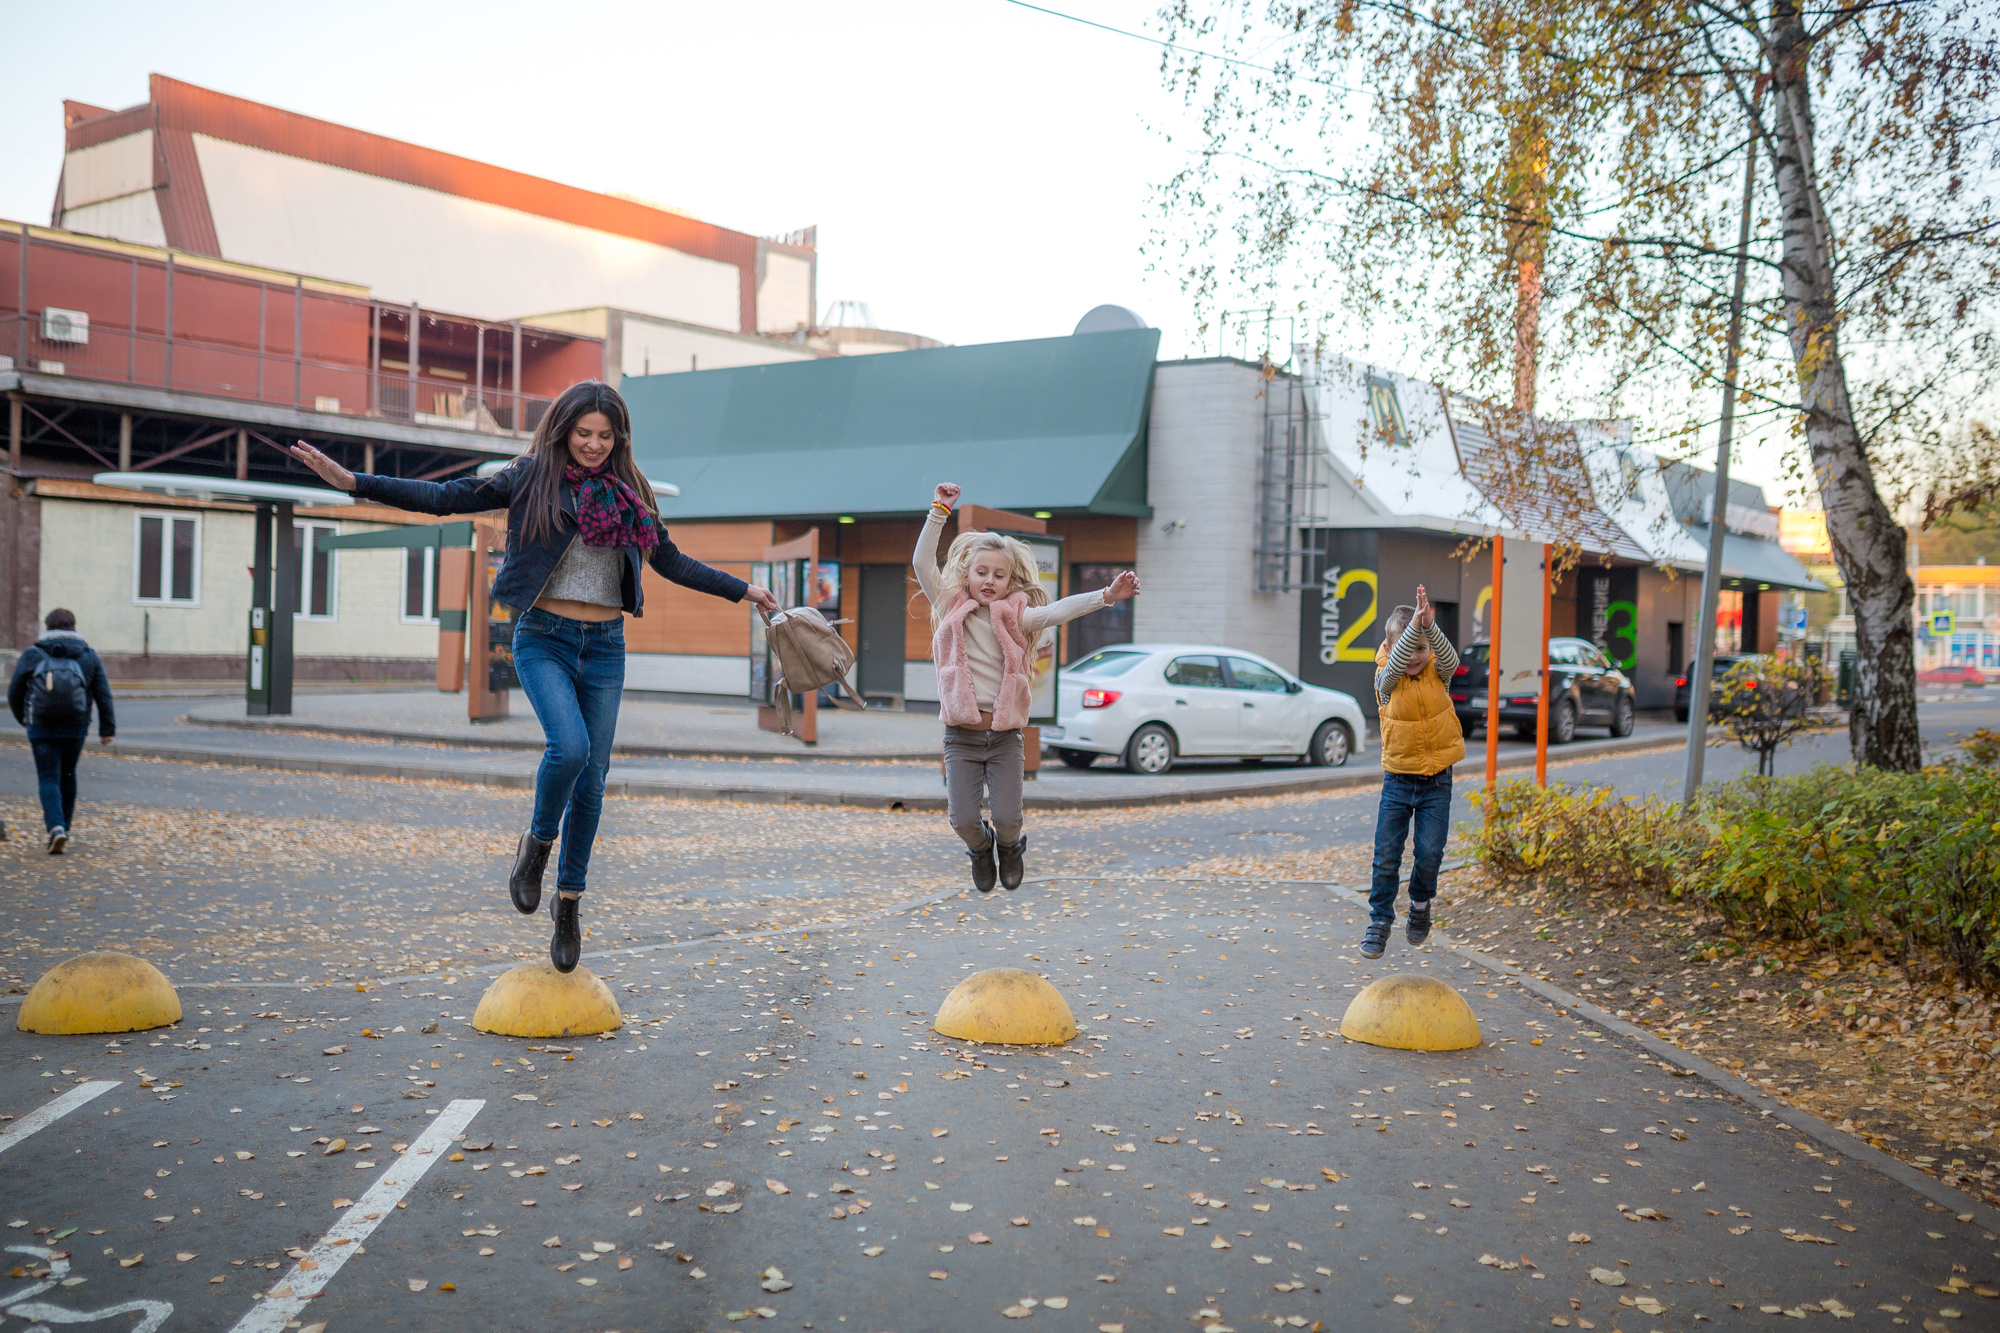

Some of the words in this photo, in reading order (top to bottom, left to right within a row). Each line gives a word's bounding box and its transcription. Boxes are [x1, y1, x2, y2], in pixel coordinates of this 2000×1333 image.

[1320, 565, 1341, 665] ОПЛАТА
[1334, 568, 1378, 662] 2
[1593, 578, 1609, 655] УЧЕНИЕ
[1606, 600, 1638, 670] 3
